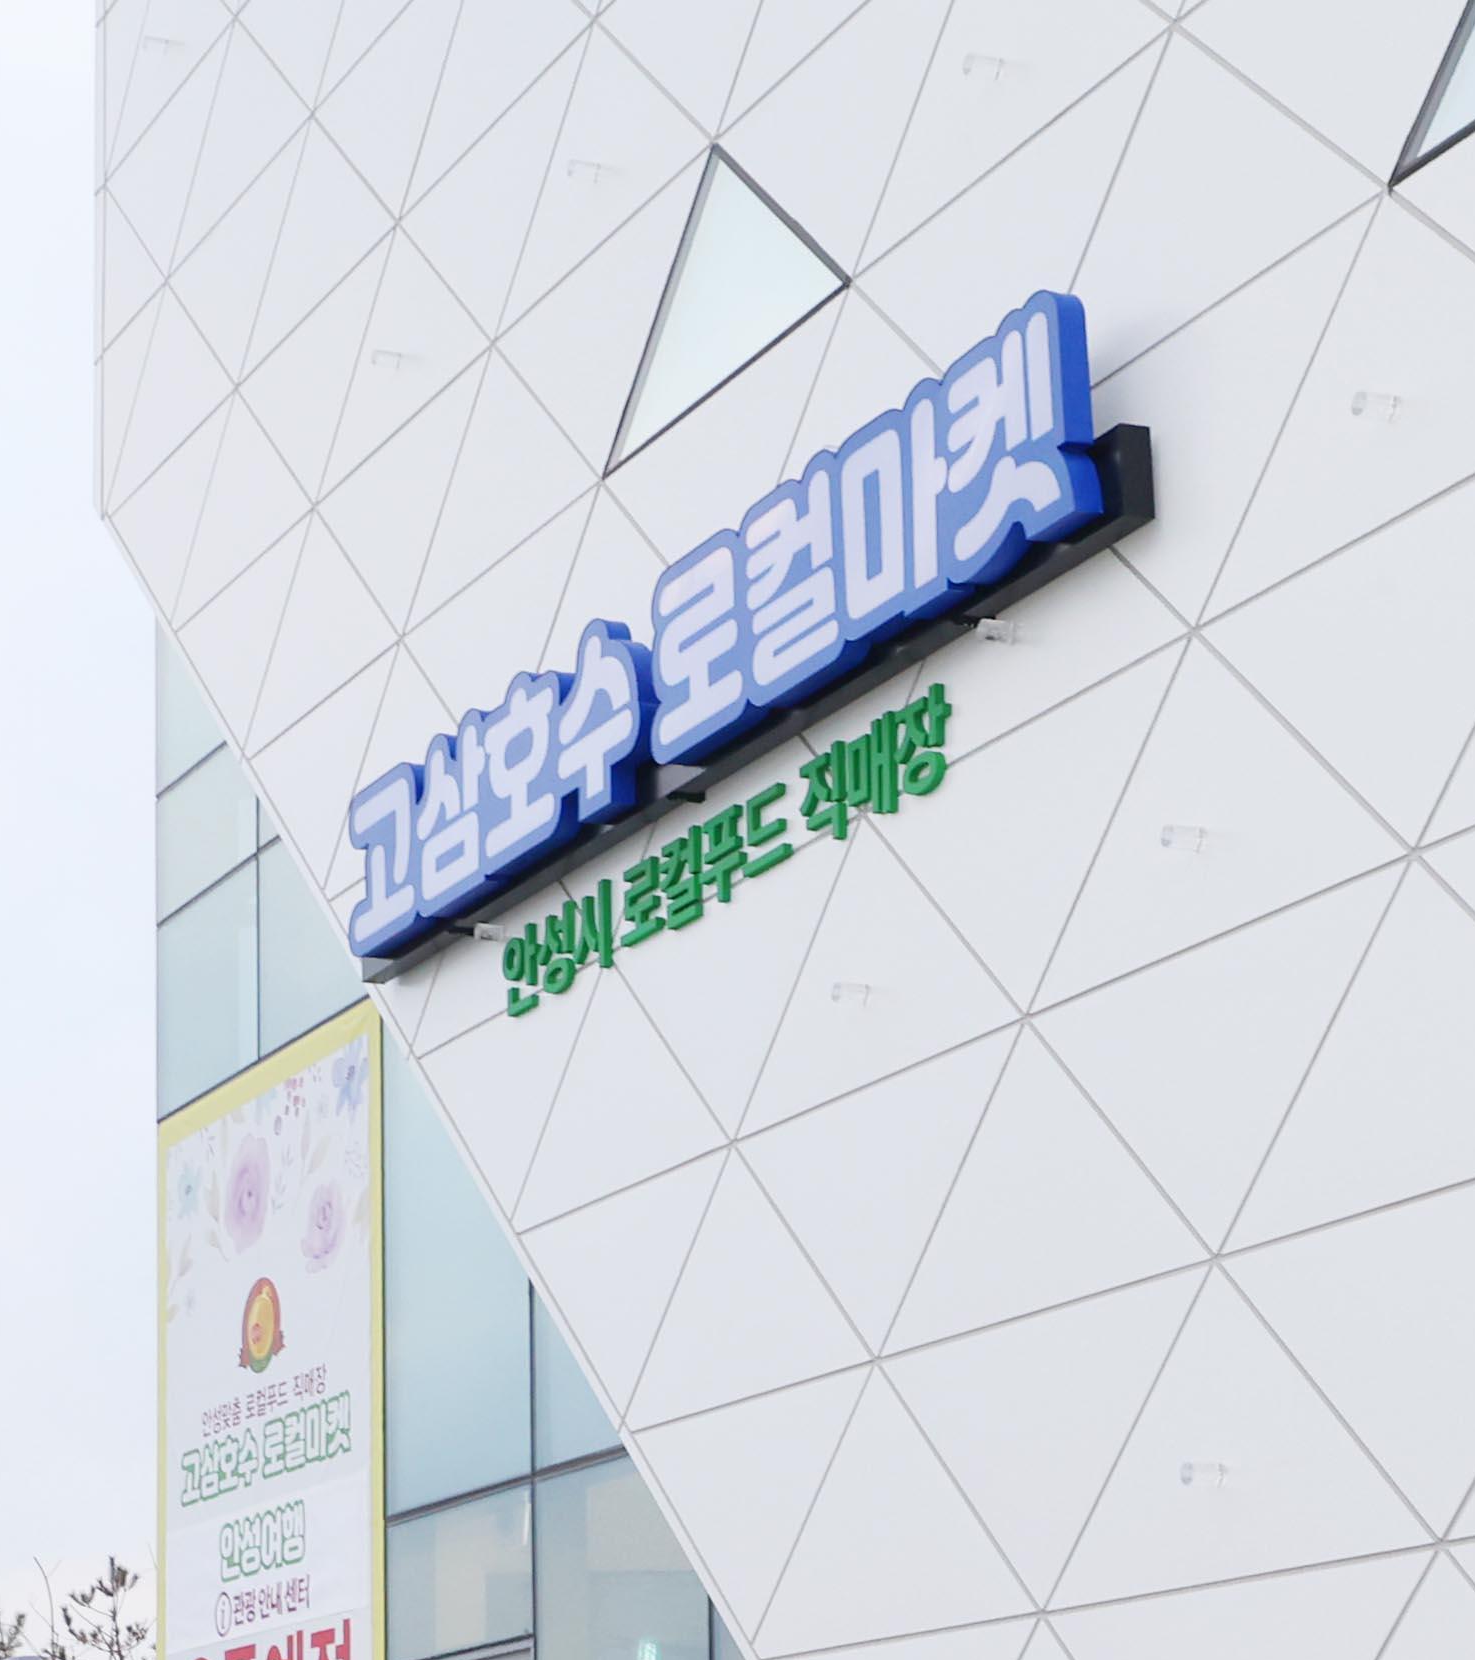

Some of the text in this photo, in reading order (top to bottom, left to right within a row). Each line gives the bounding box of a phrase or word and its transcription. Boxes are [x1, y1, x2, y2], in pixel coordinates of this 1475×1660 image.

[351, 300, 1064, 950] 고삼호수 로컬마켓
[501, 683, 952, 1016] 안성시 로컬푸드 직매장
[181, 1390, 351, 1507] 고삼호수 로컬마켓
[246, 1381, 288, 1420] 로컬푸드
[292, 1364, 327, 1400] 직매장
[219, 1499, 305, 1583] 안성여행
